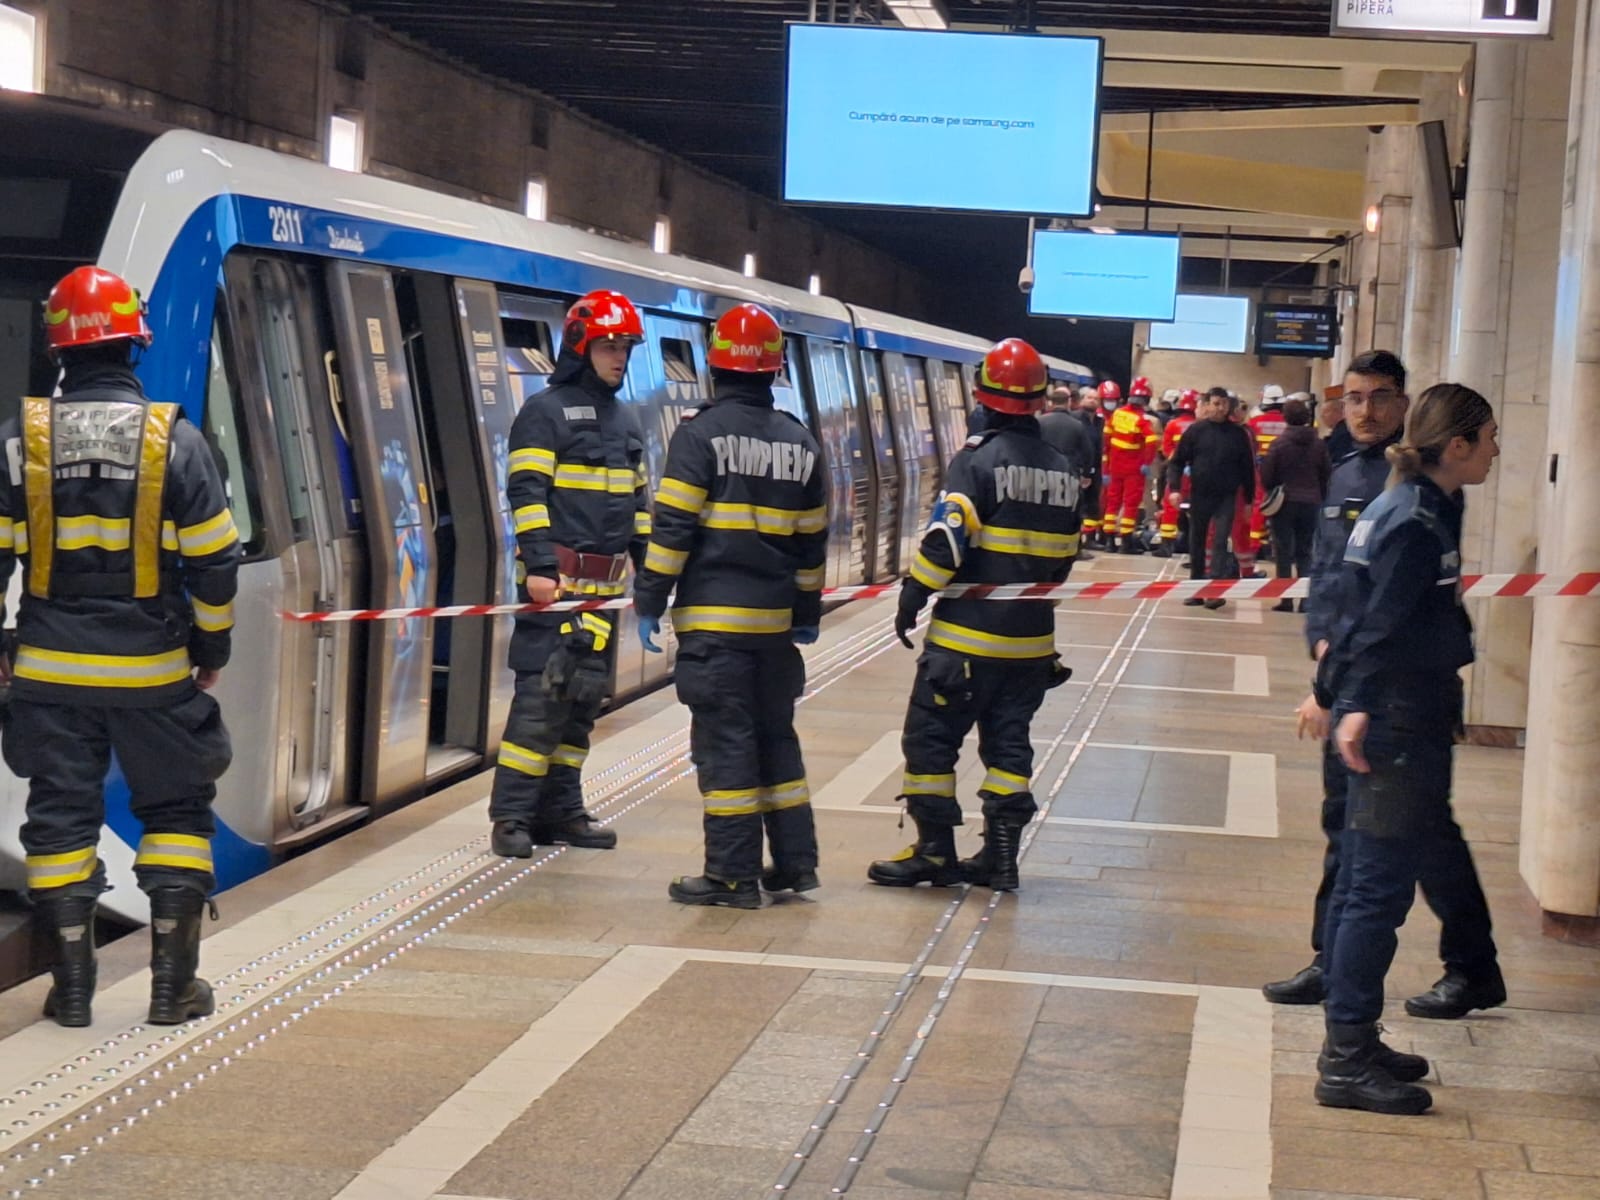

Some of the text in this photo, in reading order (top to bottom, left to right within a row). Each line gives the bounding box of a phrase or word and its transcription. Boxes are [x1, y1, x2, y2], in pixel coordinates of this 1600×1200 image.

[1346, 3, 1394, 15] PIPERA
[899, 113, 929, 123] acum
[930, 114, 945, 124] de
[946, 116, 960, 128] pe
[962, 117, 1035, 130] samsung.com
[268, 206, 304, 244] 2311
